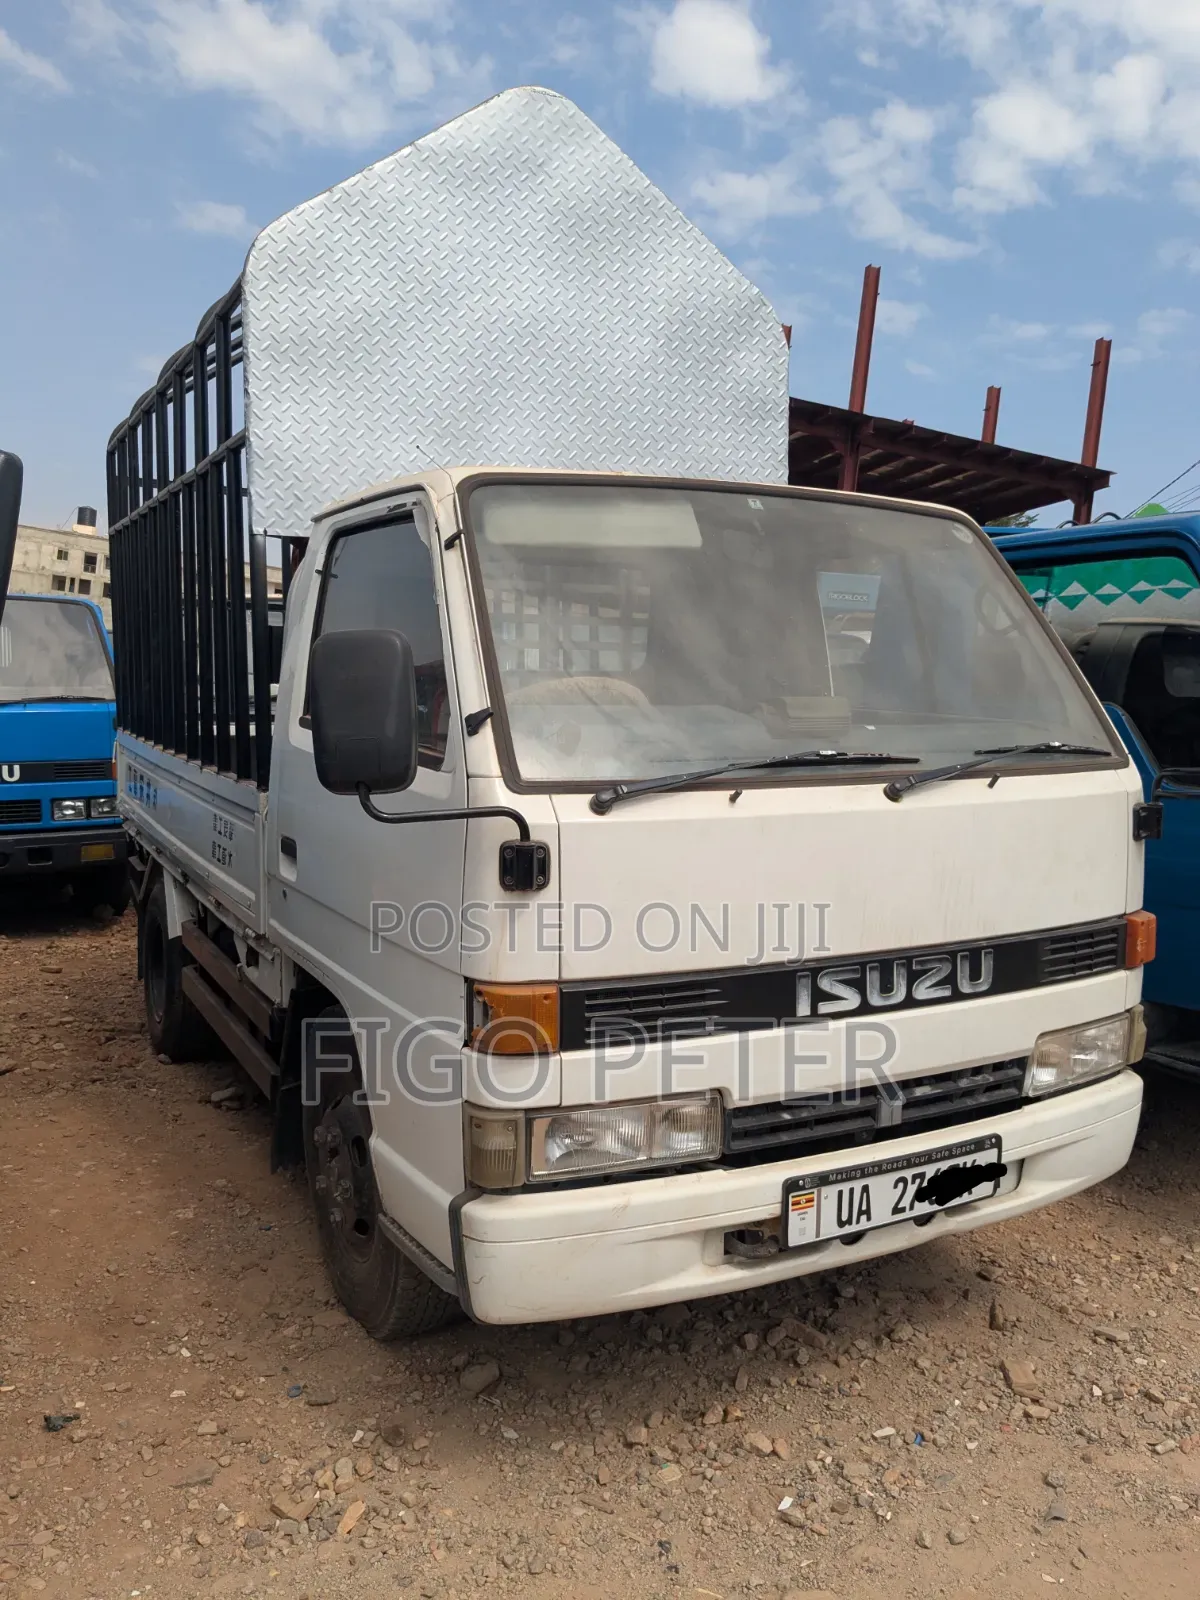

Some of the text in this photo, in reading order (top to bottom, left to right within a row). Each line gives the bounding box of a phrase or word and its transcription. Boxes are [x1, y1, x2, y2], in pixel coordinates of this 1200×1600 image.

[796, 948, 994, 1017] ISUZU
[828, 1170, 861, 1182] Making
[864, 1165, 879, 1175] the
[881, 1160, 907, 1171] Roads
[910, 1155, 928, 1165] Your
[931, 1150, 949, 1160] Safe
[951, 1143, 975, 1155] Space
[837, 1183, 872, 1229] UA
